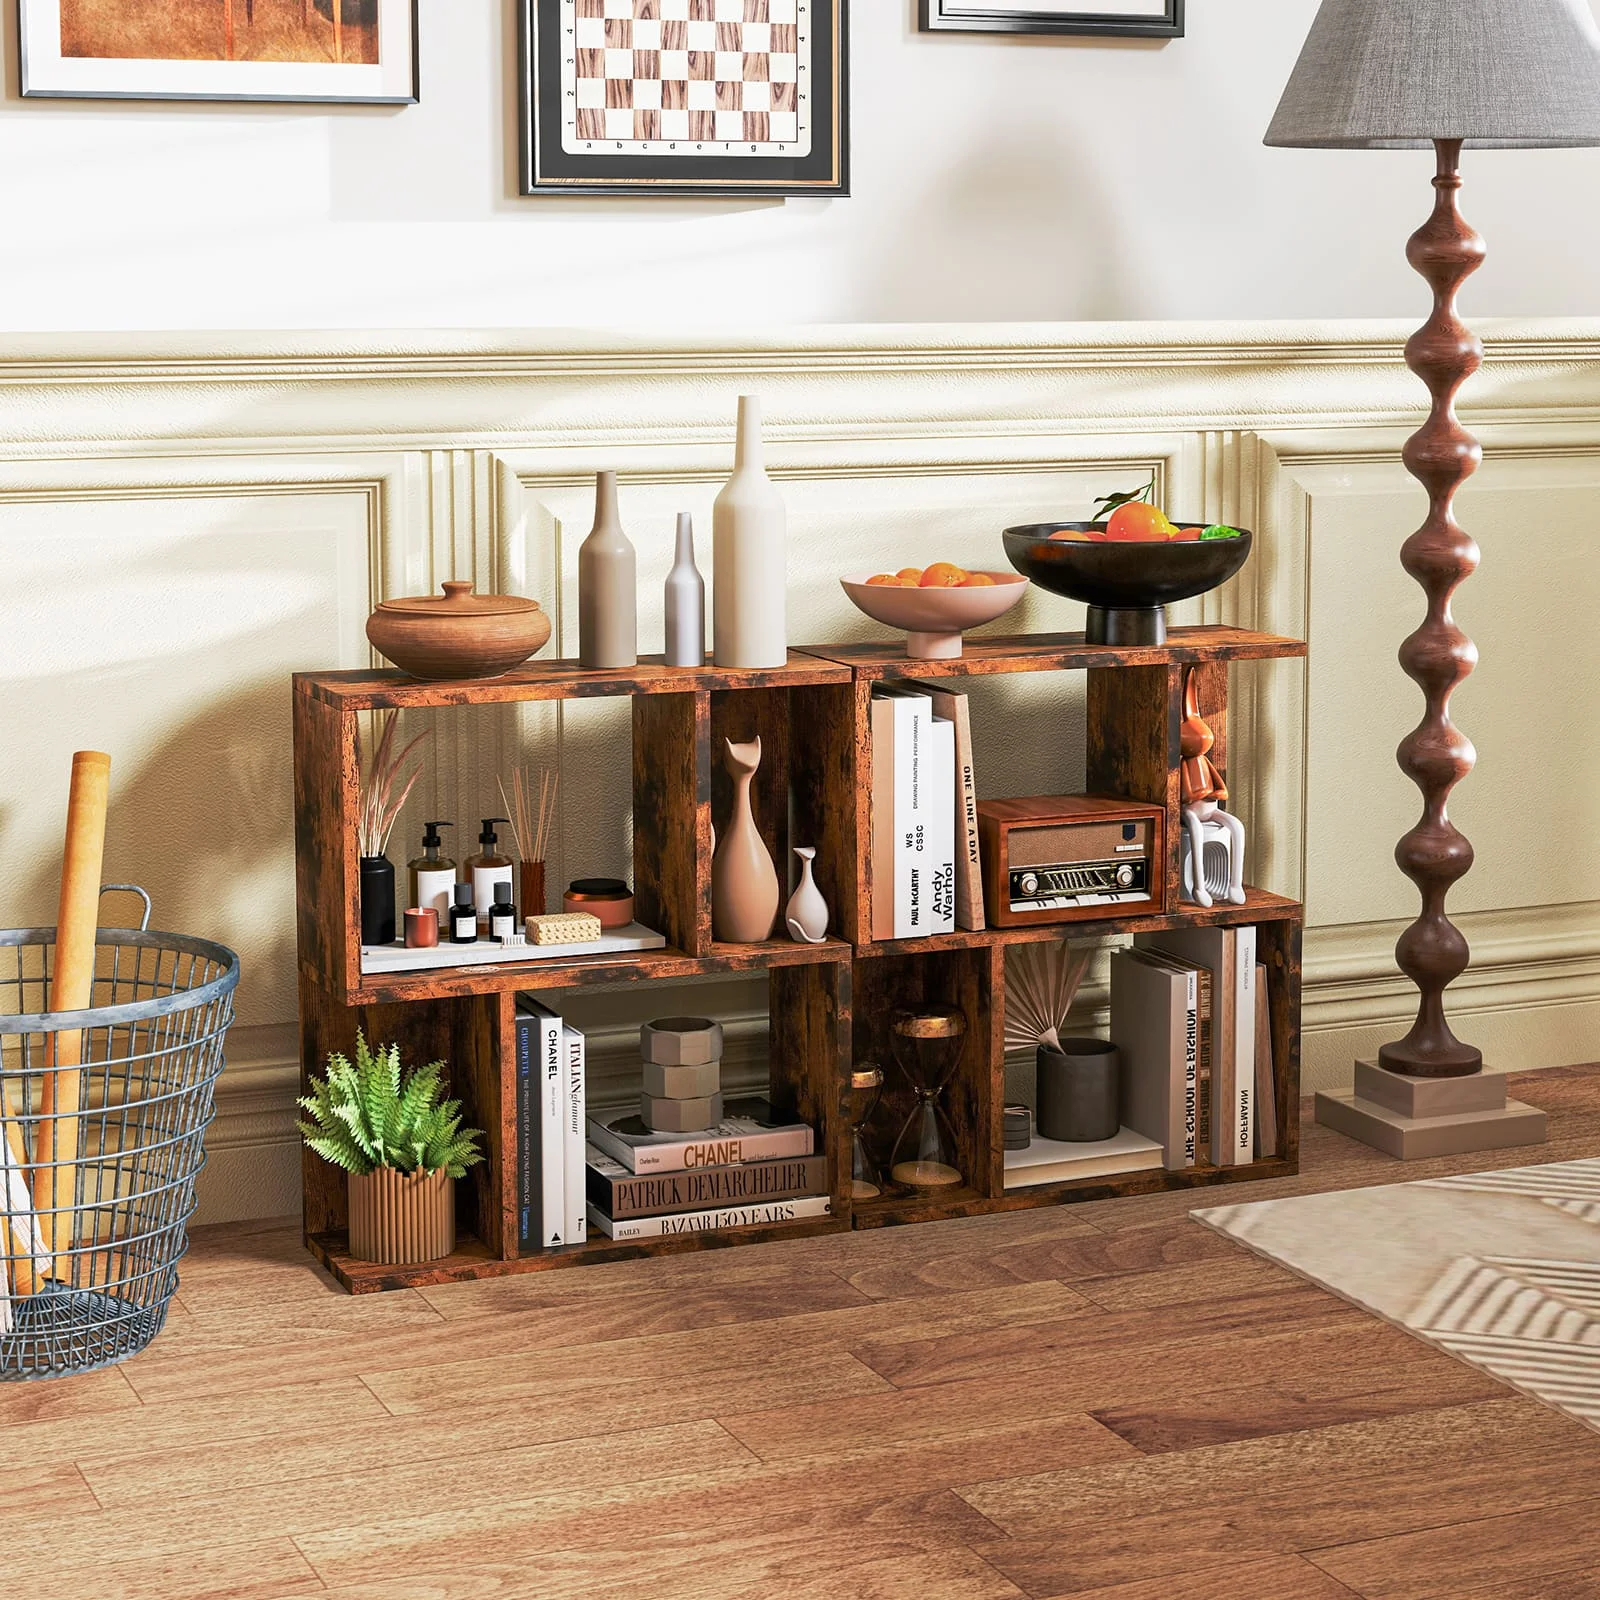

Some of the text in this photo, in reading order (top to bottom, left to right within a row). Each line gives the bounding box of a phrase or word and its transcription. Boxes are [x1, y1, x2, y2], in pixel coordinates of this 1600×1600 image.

[616, 141, 622, 149] b
[669, 142, 676, 150] d
[725, 142, 729, 150] f
[750, 144, 757, 152] g
[779, 143, 785, 151] h
[963, 766, 978, 864] ONE LINE A DAY
[906, 833, 913, 848] WS
[916, 825, 924, 851] CSSC
[911, 868, 919, 925] PAUL McCARTHY
[932, 871, 945, 914] Andy
[943, 863, 953, 921] Warhol
[520, 1027, 529, 1077] CHOUPETTE
[548, 1029, 558, 1080] CHANEL
[683, 1140, 746, 1168] CHANEL
[617, 1163, 808, 1211] PATRICK DEMARCHELIER
[618, 1228, 641, 1238] BAILEY
[661, 1213, 711, 1235] BAZAAR
[739, 1204, 795, 1225] YEARS
